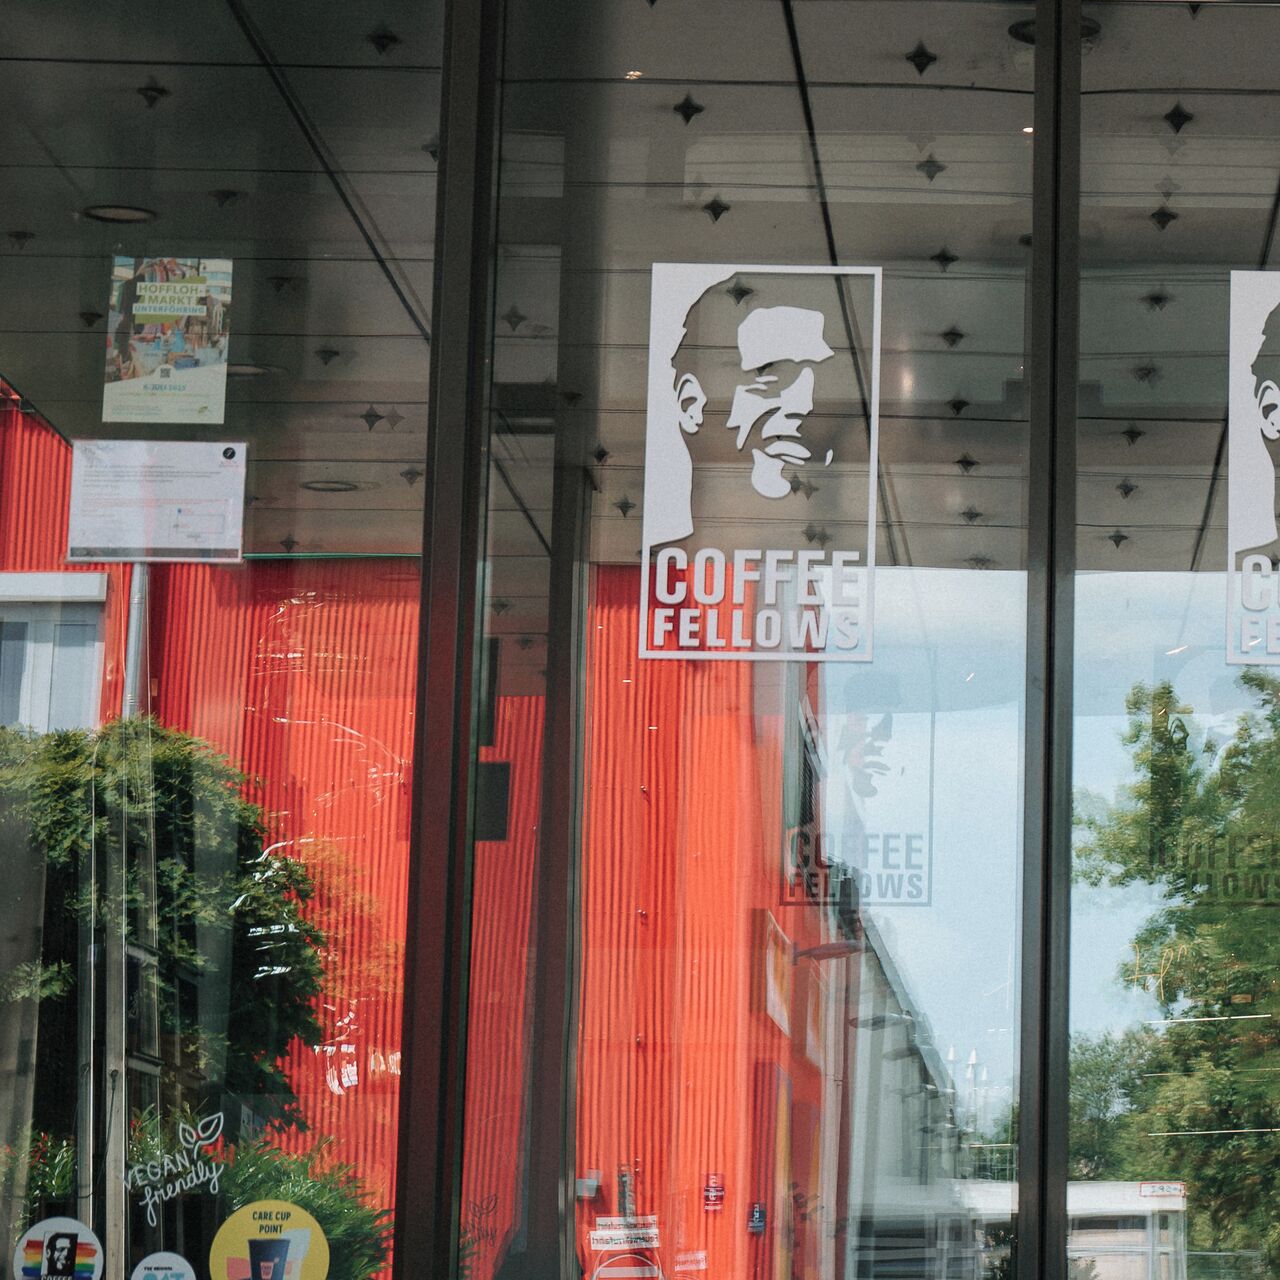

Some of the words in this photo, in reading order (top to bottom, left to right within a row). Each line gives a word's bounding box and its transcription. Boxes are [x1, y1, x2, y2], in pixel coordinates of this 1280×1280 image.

[139, 284, 204, 295] HOFFLOH-
[147, 295, 192, 305] MARKT
[134, 305, 205, 315] UNTERFÖHRING
[655, 547, 860, 607] COFFEE
[653, 608, 860, 650] FELLOWS
[123, 1149, 190, 1190] VEGAN
[138, 1160, 225, 1227] friendly
[252, 1211, 273, 1221] CARE
[275, 1211, 291, 1221] CUP
[259, 1223, 284, 1234] POINT
